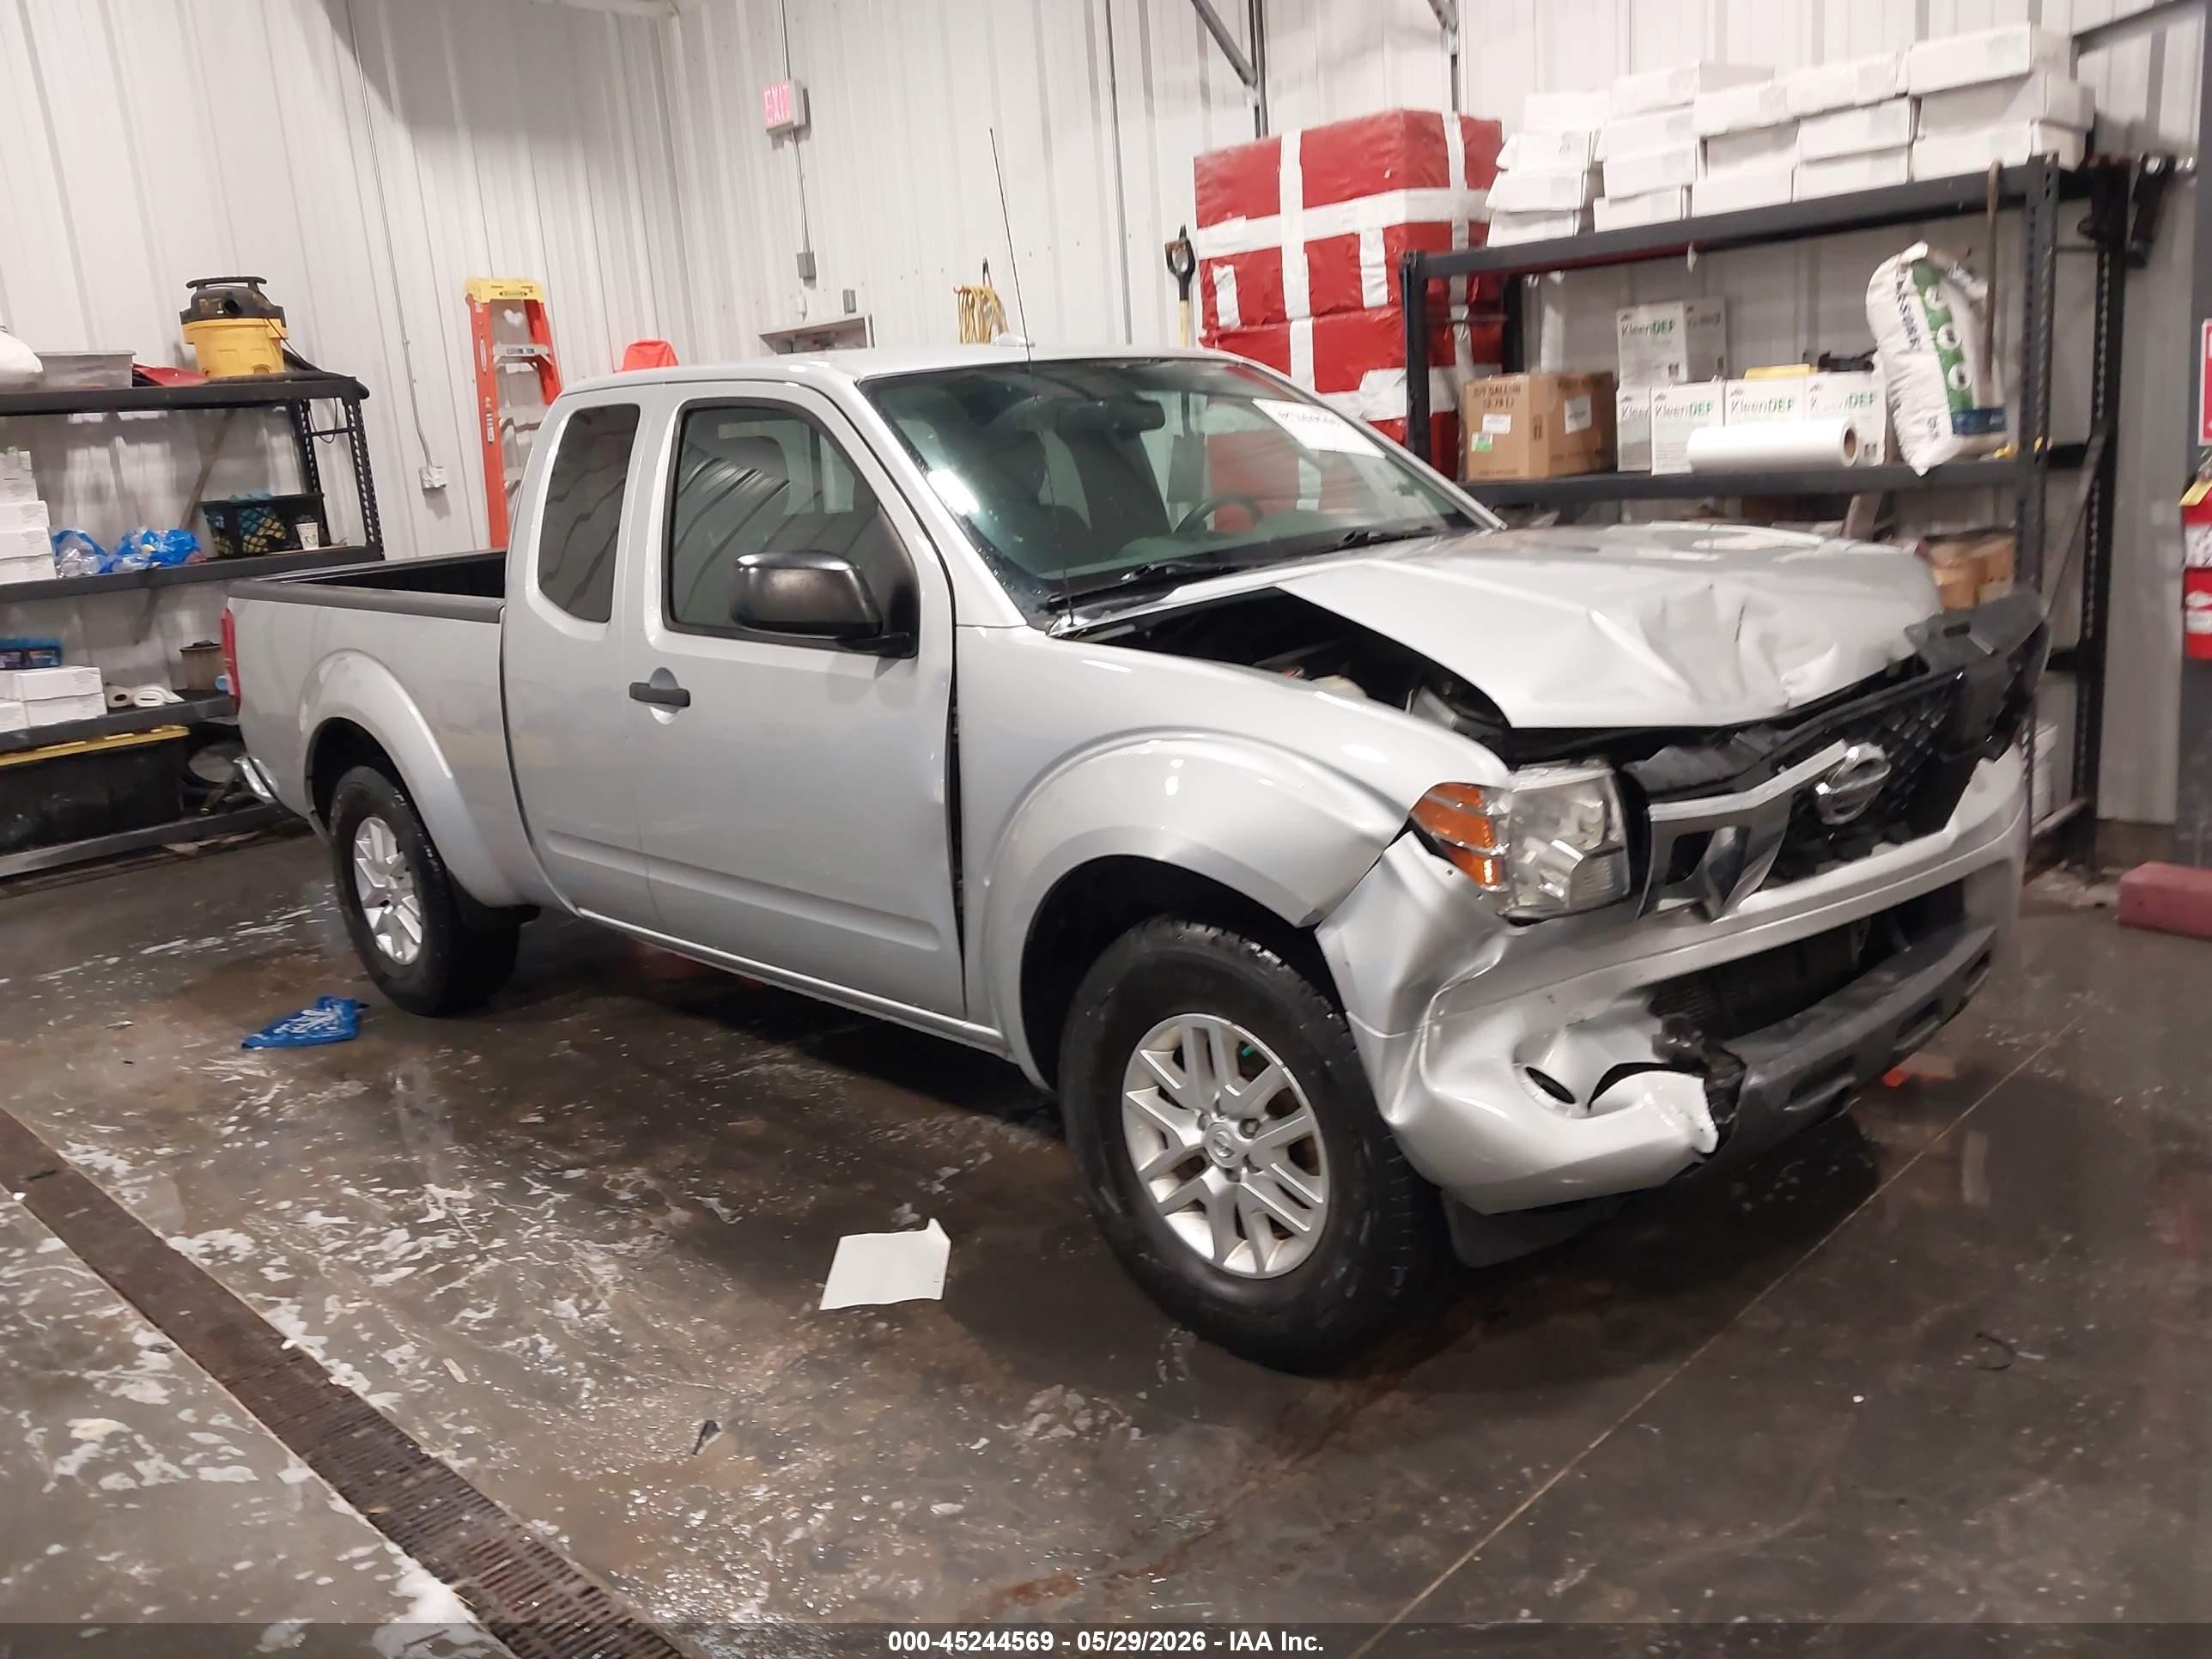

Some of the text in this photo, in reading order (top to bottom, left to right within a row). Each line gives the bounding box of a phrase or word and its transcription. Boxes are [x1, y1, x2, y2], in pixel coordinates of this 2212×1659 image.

[763, 84, 790, 125] EXIT
[1656, 400, 1713, 419] KleenDEF
[1731, 398, 1795, 413] KleenDEF
[1810, 392, 1877, 412] KnDEF
